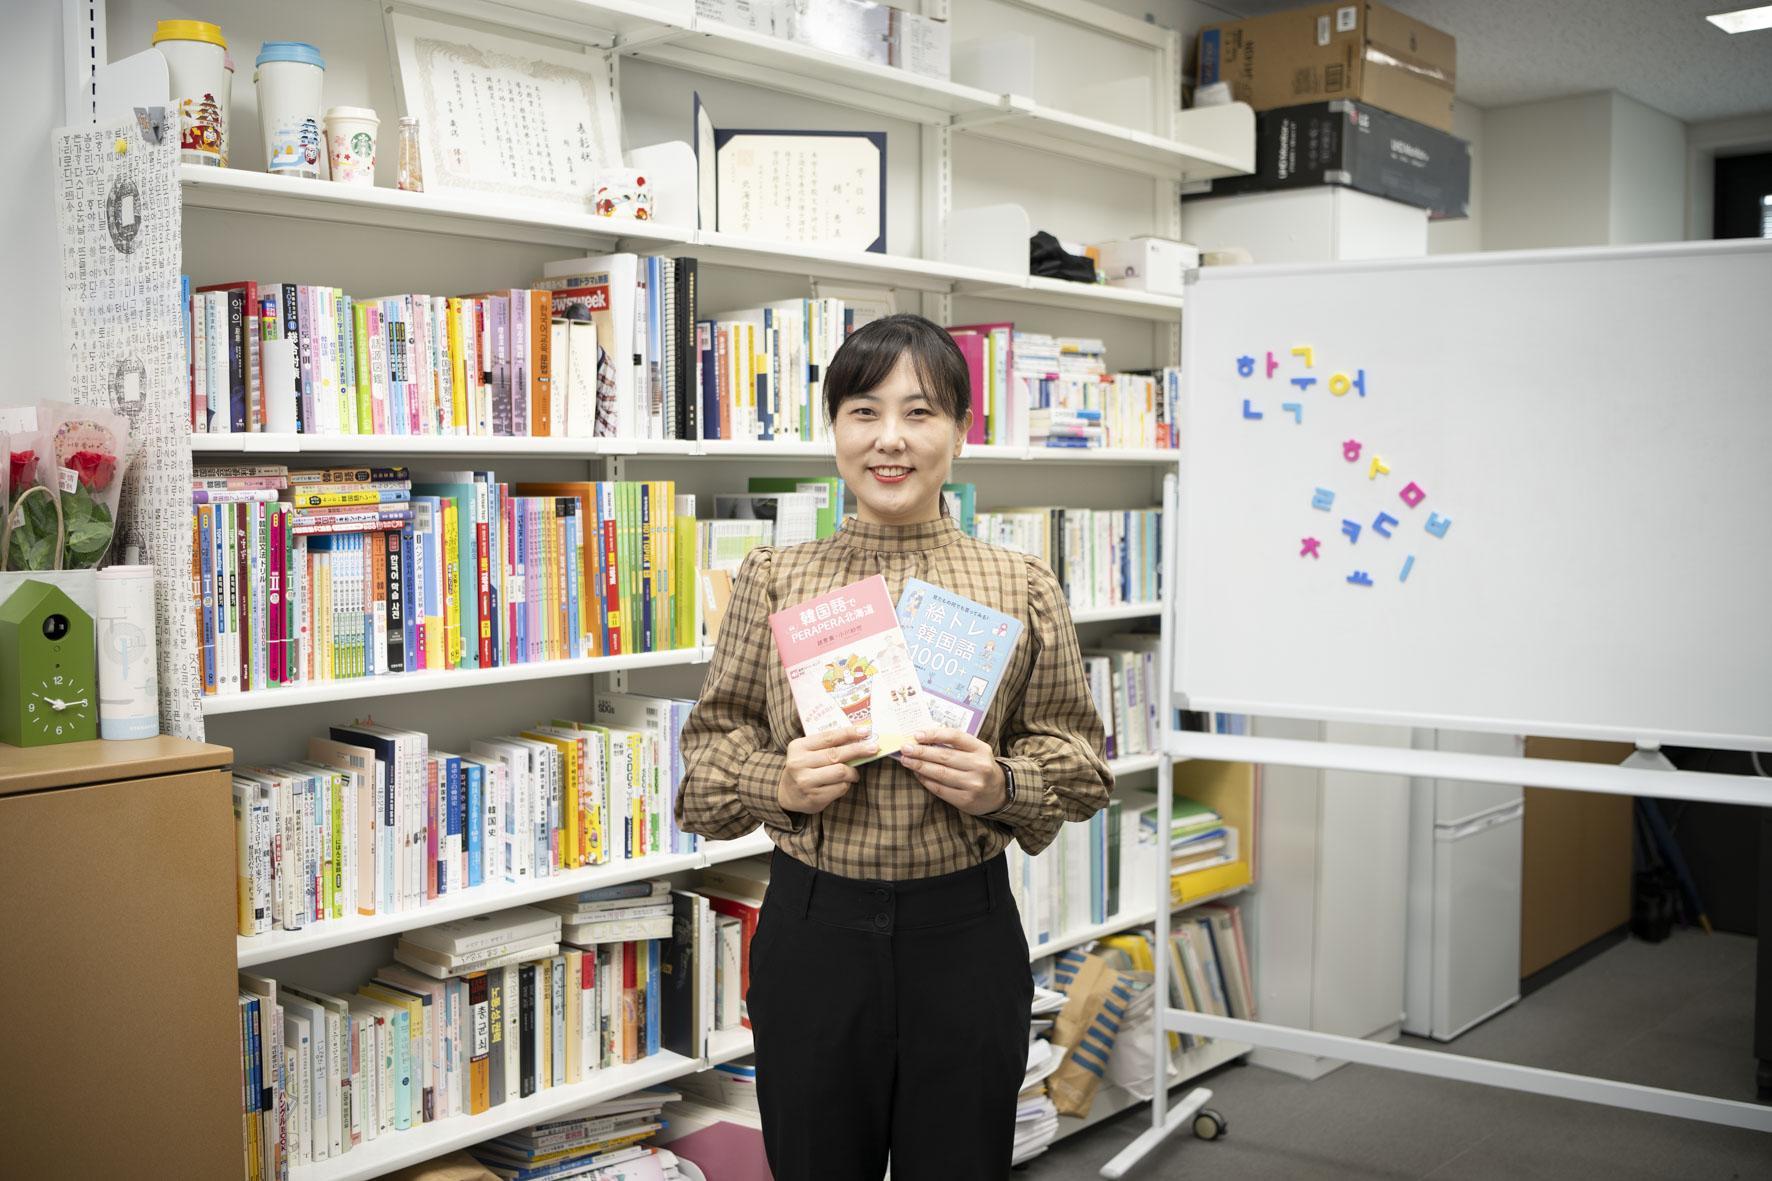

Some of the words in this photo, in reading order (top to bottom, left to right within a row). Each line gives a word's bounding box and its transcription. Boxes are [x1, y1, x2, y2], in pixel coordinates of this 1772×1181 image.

[799, 596, 857, 626] 韓国語で
[925, 602, 984, 635] 絵トレ
[917, 623, 977, 661] 韓国語
[53, 676, 63, 685] 12
[28, 703, 35, 712] 9
[56, 726, 63, 735] 6
